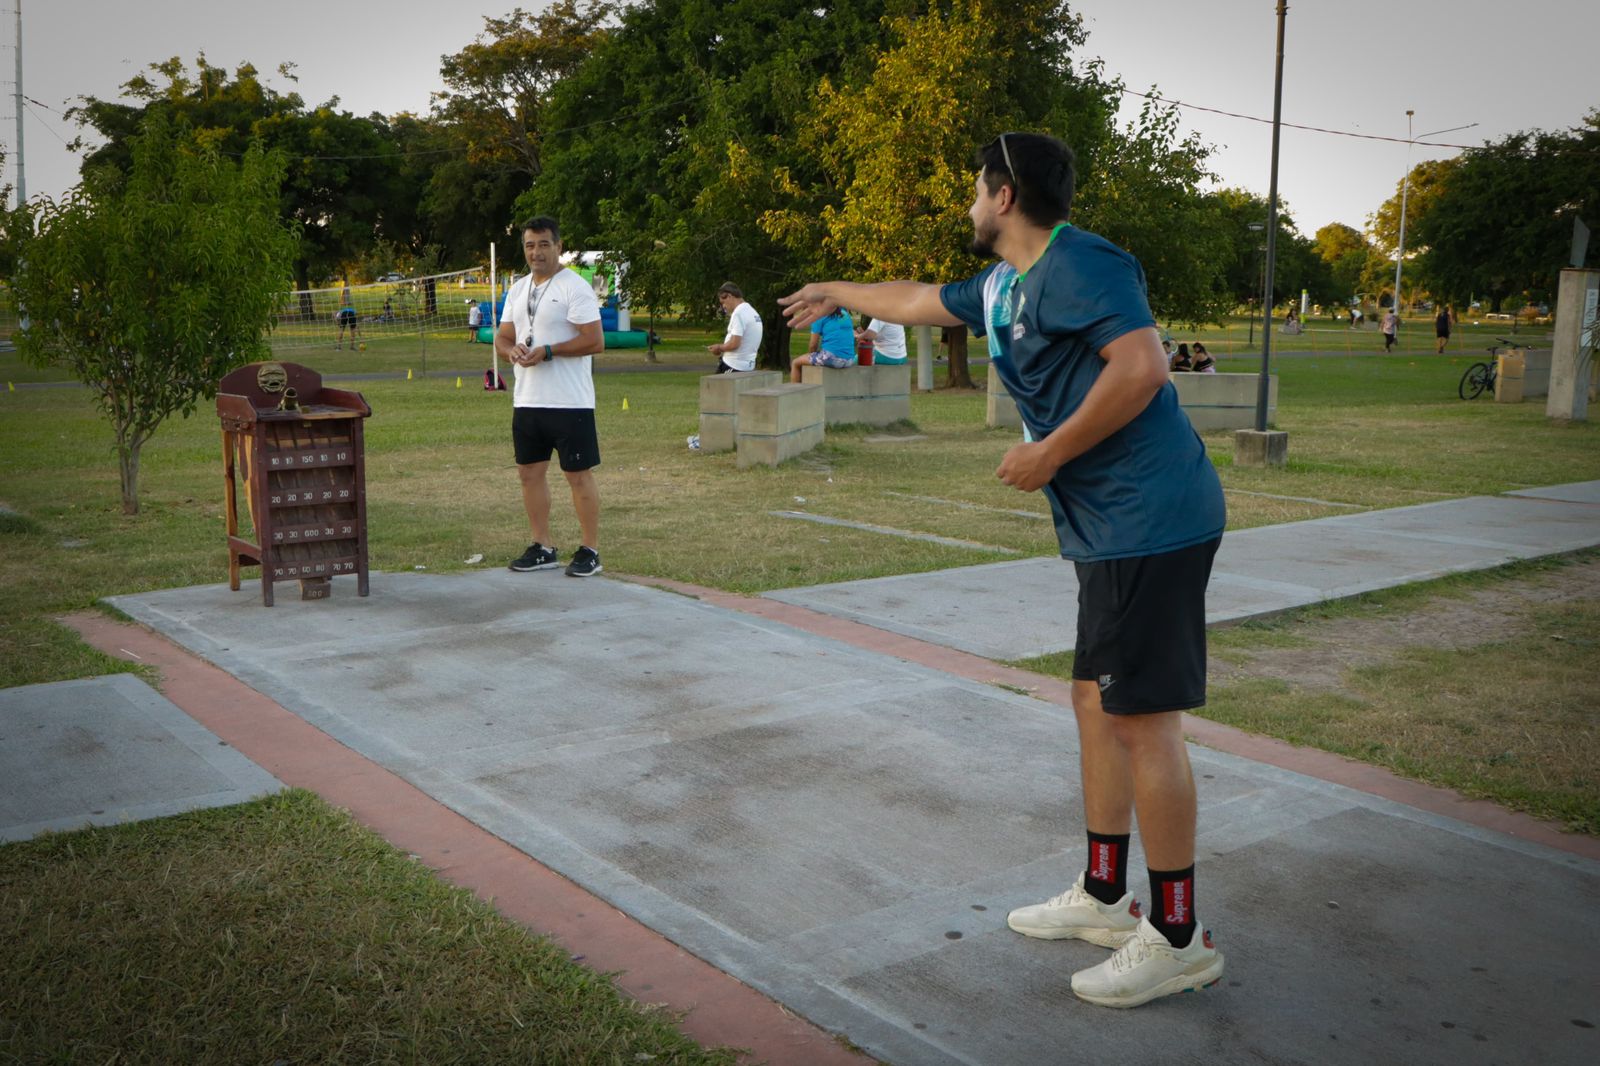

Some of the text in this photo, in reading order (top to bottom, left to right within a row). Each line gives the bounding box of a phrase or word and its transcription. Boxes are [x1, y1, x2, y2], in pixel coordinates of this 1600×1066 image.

[336, 452, 346, 461] 10
[289, 530, 298, 539] 30
[325, 527, 335, 536] 30
[342, 526, 352, 534] 30
[344, 561, 354, 570] 70
[1091, 843, 1113, 880] Supreme
[1167, 881, 1188, 923] Supreme
